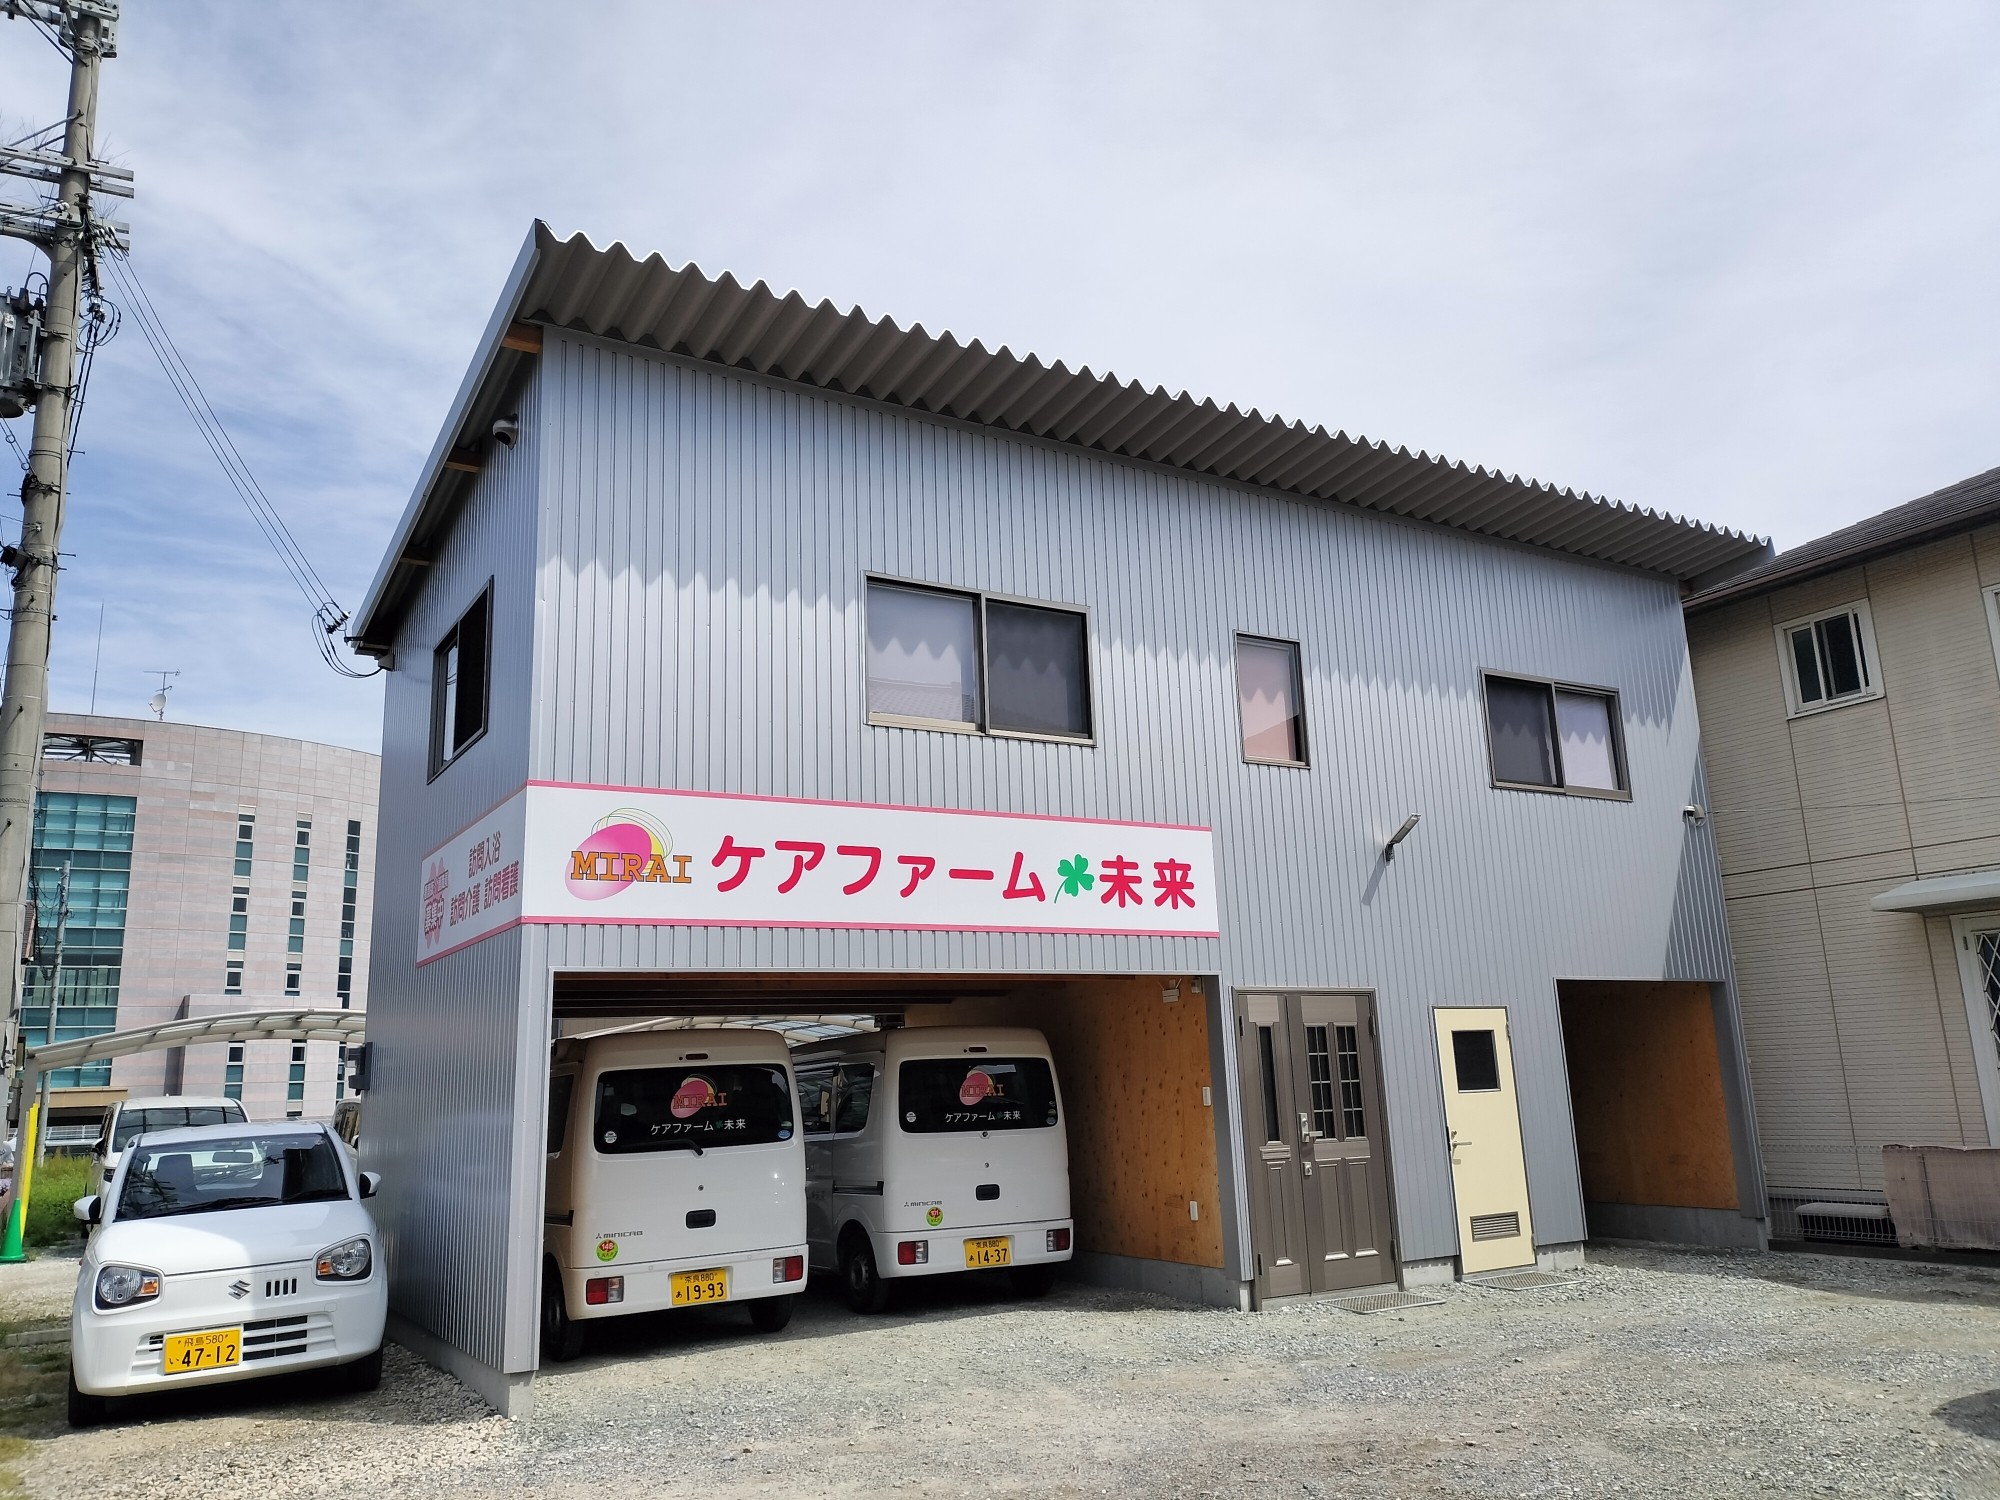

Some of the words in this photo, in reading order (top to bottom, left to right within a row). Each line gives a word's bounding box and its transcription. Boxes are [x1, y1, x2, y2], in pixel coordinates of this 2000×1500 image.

[468, 830, 501, 879] 訪問入浴
[571, 850, 693, 884] MIRAI
[711, 835, 1046, 902] ケアファーム
[1100, 855, 1196, 910] 未来
[450, 883, 481, 927] 訪問介護
[484, 860, 520, 910] 訪問看護
[673, 1092, 727, 1109] MIRAI
[961, 1084, 1005, 1098] MIRAI
[945, 1111, 996, 1123] ケアファーム
[1003, 1110, 1022, 1121] 未来
[651, 1120, 714, 1136] ケアファーム
[724, 1118, 746, 1131] 未来
[977, 1248, 1008, 1265] 14-37
[686, 1282, 724, 1301] 19-93
[181, 1344, 236, 1367] 47-12
